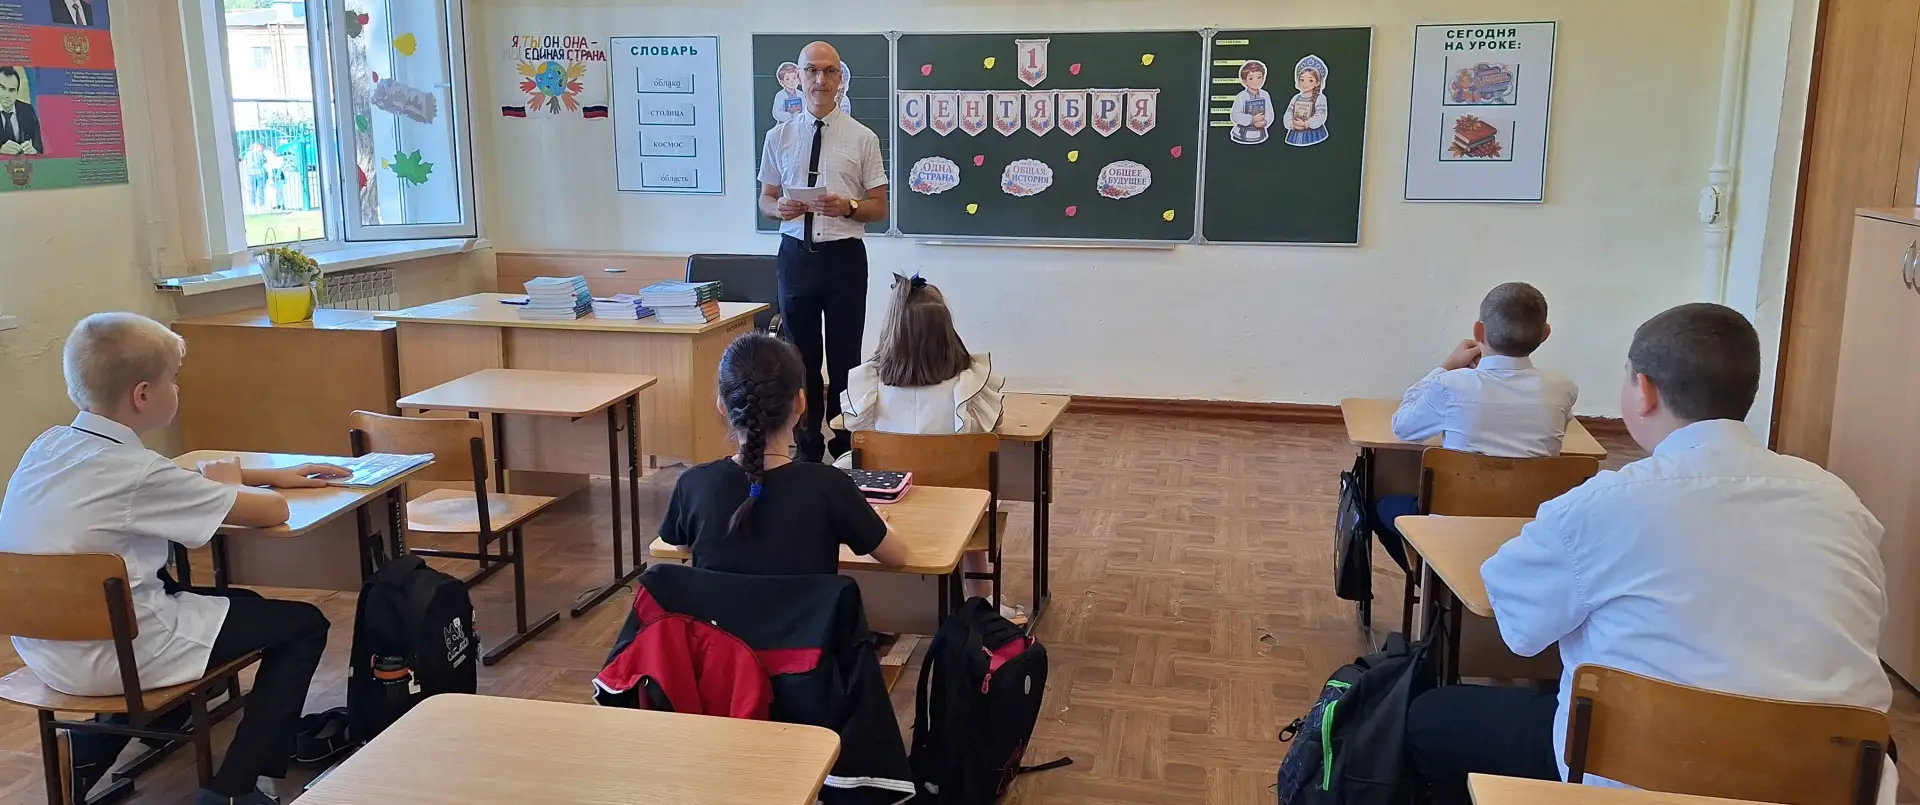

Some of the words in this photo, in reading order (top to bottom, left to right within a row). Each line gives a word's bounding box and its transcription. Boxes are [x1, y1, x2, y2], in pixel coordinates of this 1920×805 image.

[1446, 28, 1517, 39] СЕГОДНЯ
[563, 35, 588, 49] ОНА
[1444, 41, 1464, 51] НА
[1469, 40, 1522, 50] УРОКЕ:
[525, 47, 565, 60] ЕДИНАЯ
[630, 45, 699, 56] СЛОВАРЬ
[1027, 48, 1037, 69] 1
[905, 98, 1149, 119] СЕНТЯБРЯ
[923, 162, 953, 173] ОДНА
[1108, 168, 1143, 178] ОБЩЕЕ
[918, 171, 955, 183] СТРАНА
[1012, 174, 1049, 184] ИСТОРИЯ
[1107, 176, 1147, 186] БУДУЩЕЕ
